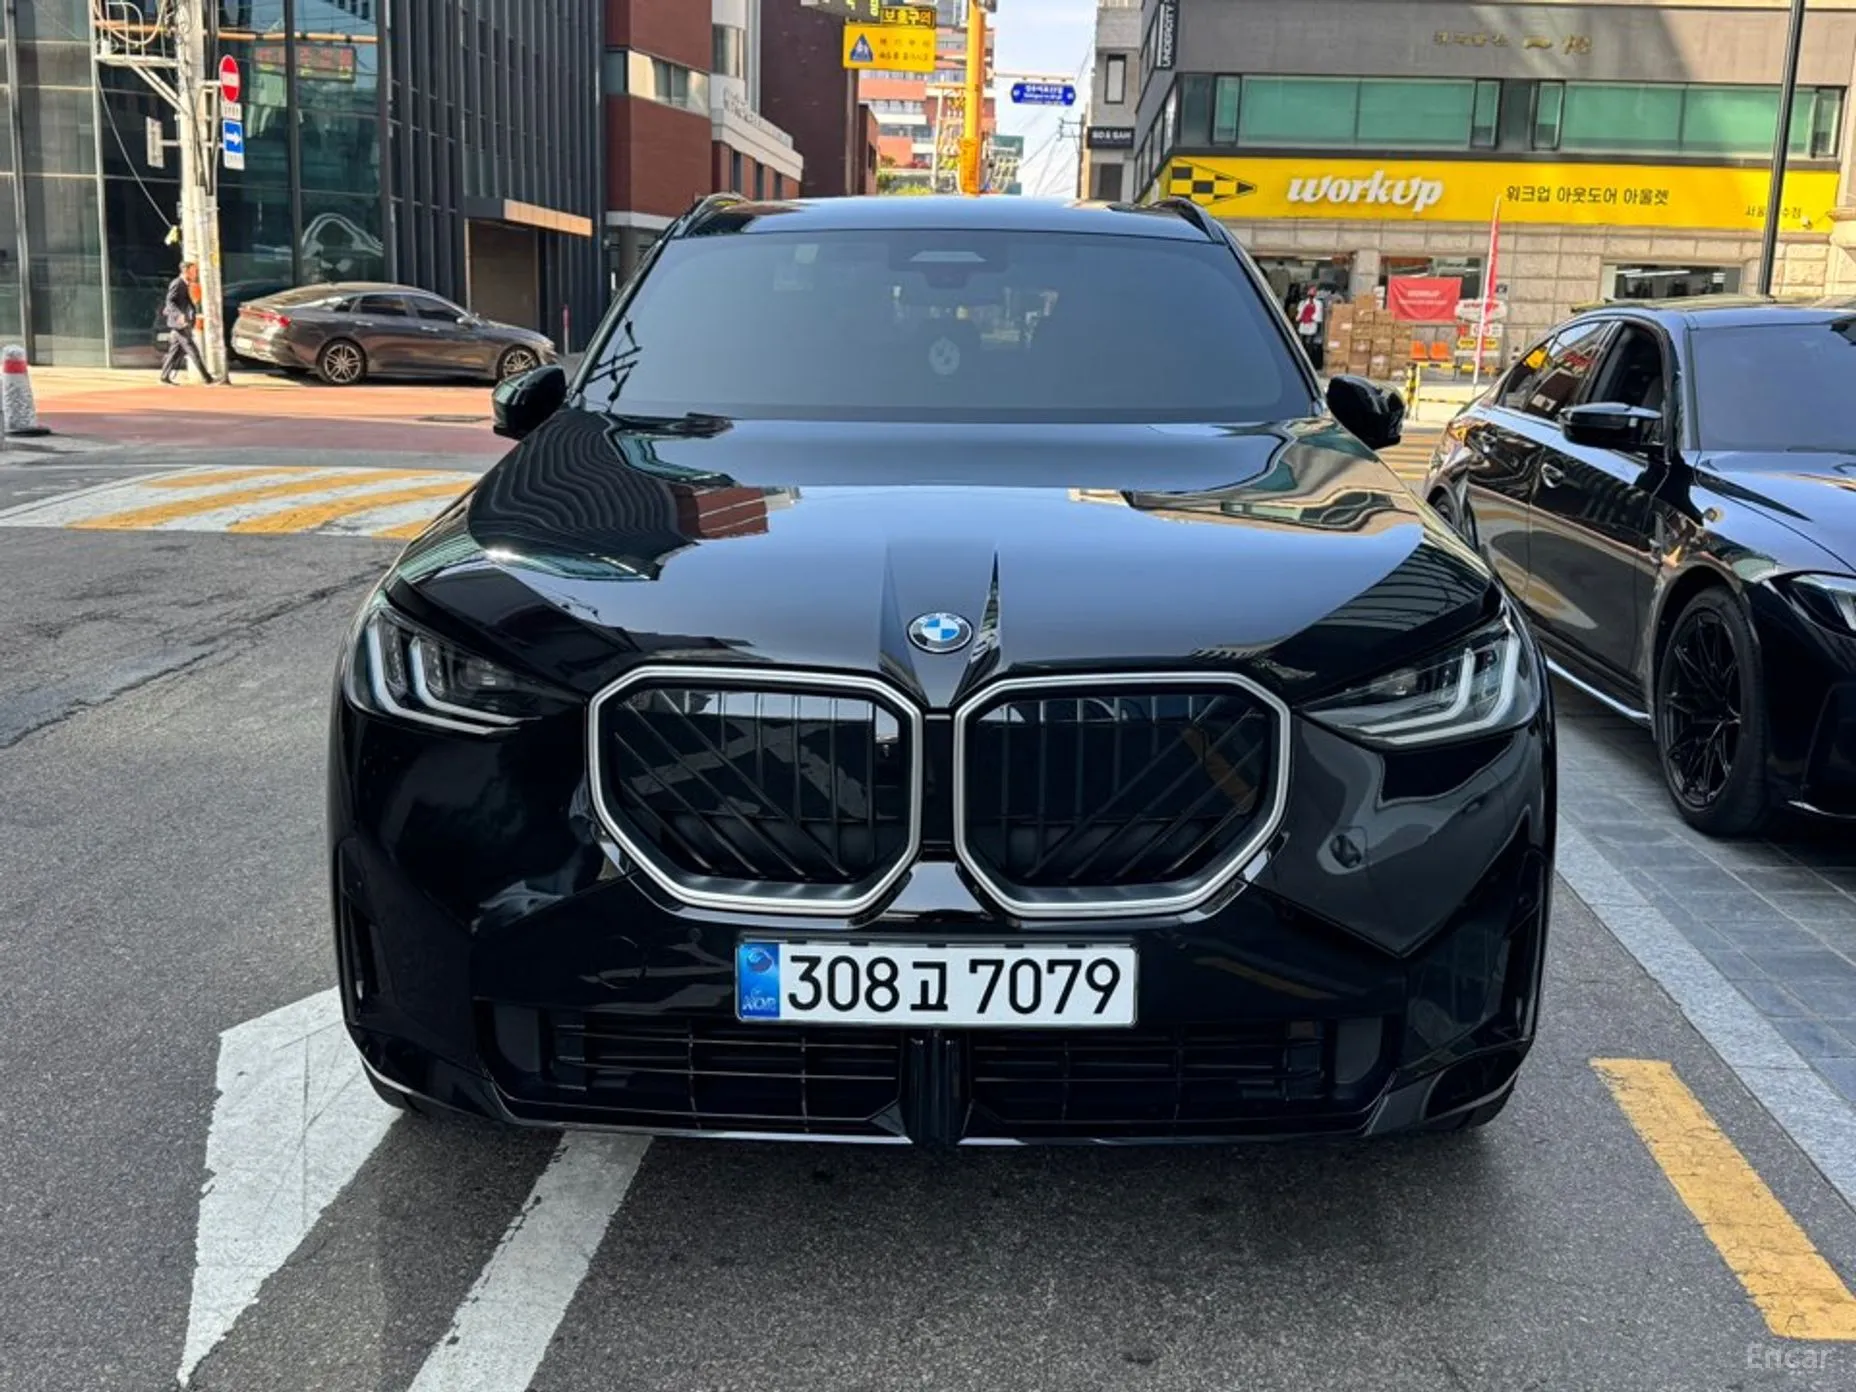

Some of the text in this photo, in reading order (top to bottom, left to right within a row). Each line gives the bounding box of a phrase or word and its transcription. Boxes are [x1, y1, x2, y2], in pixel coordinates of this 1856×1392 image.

[1162, 5, 1175, 67] UNDERCITY
[1506, 185, 1670, 206] 워크업 아웃도어 아울렛
[788, 955, 1121, 1014] 308고 7079
